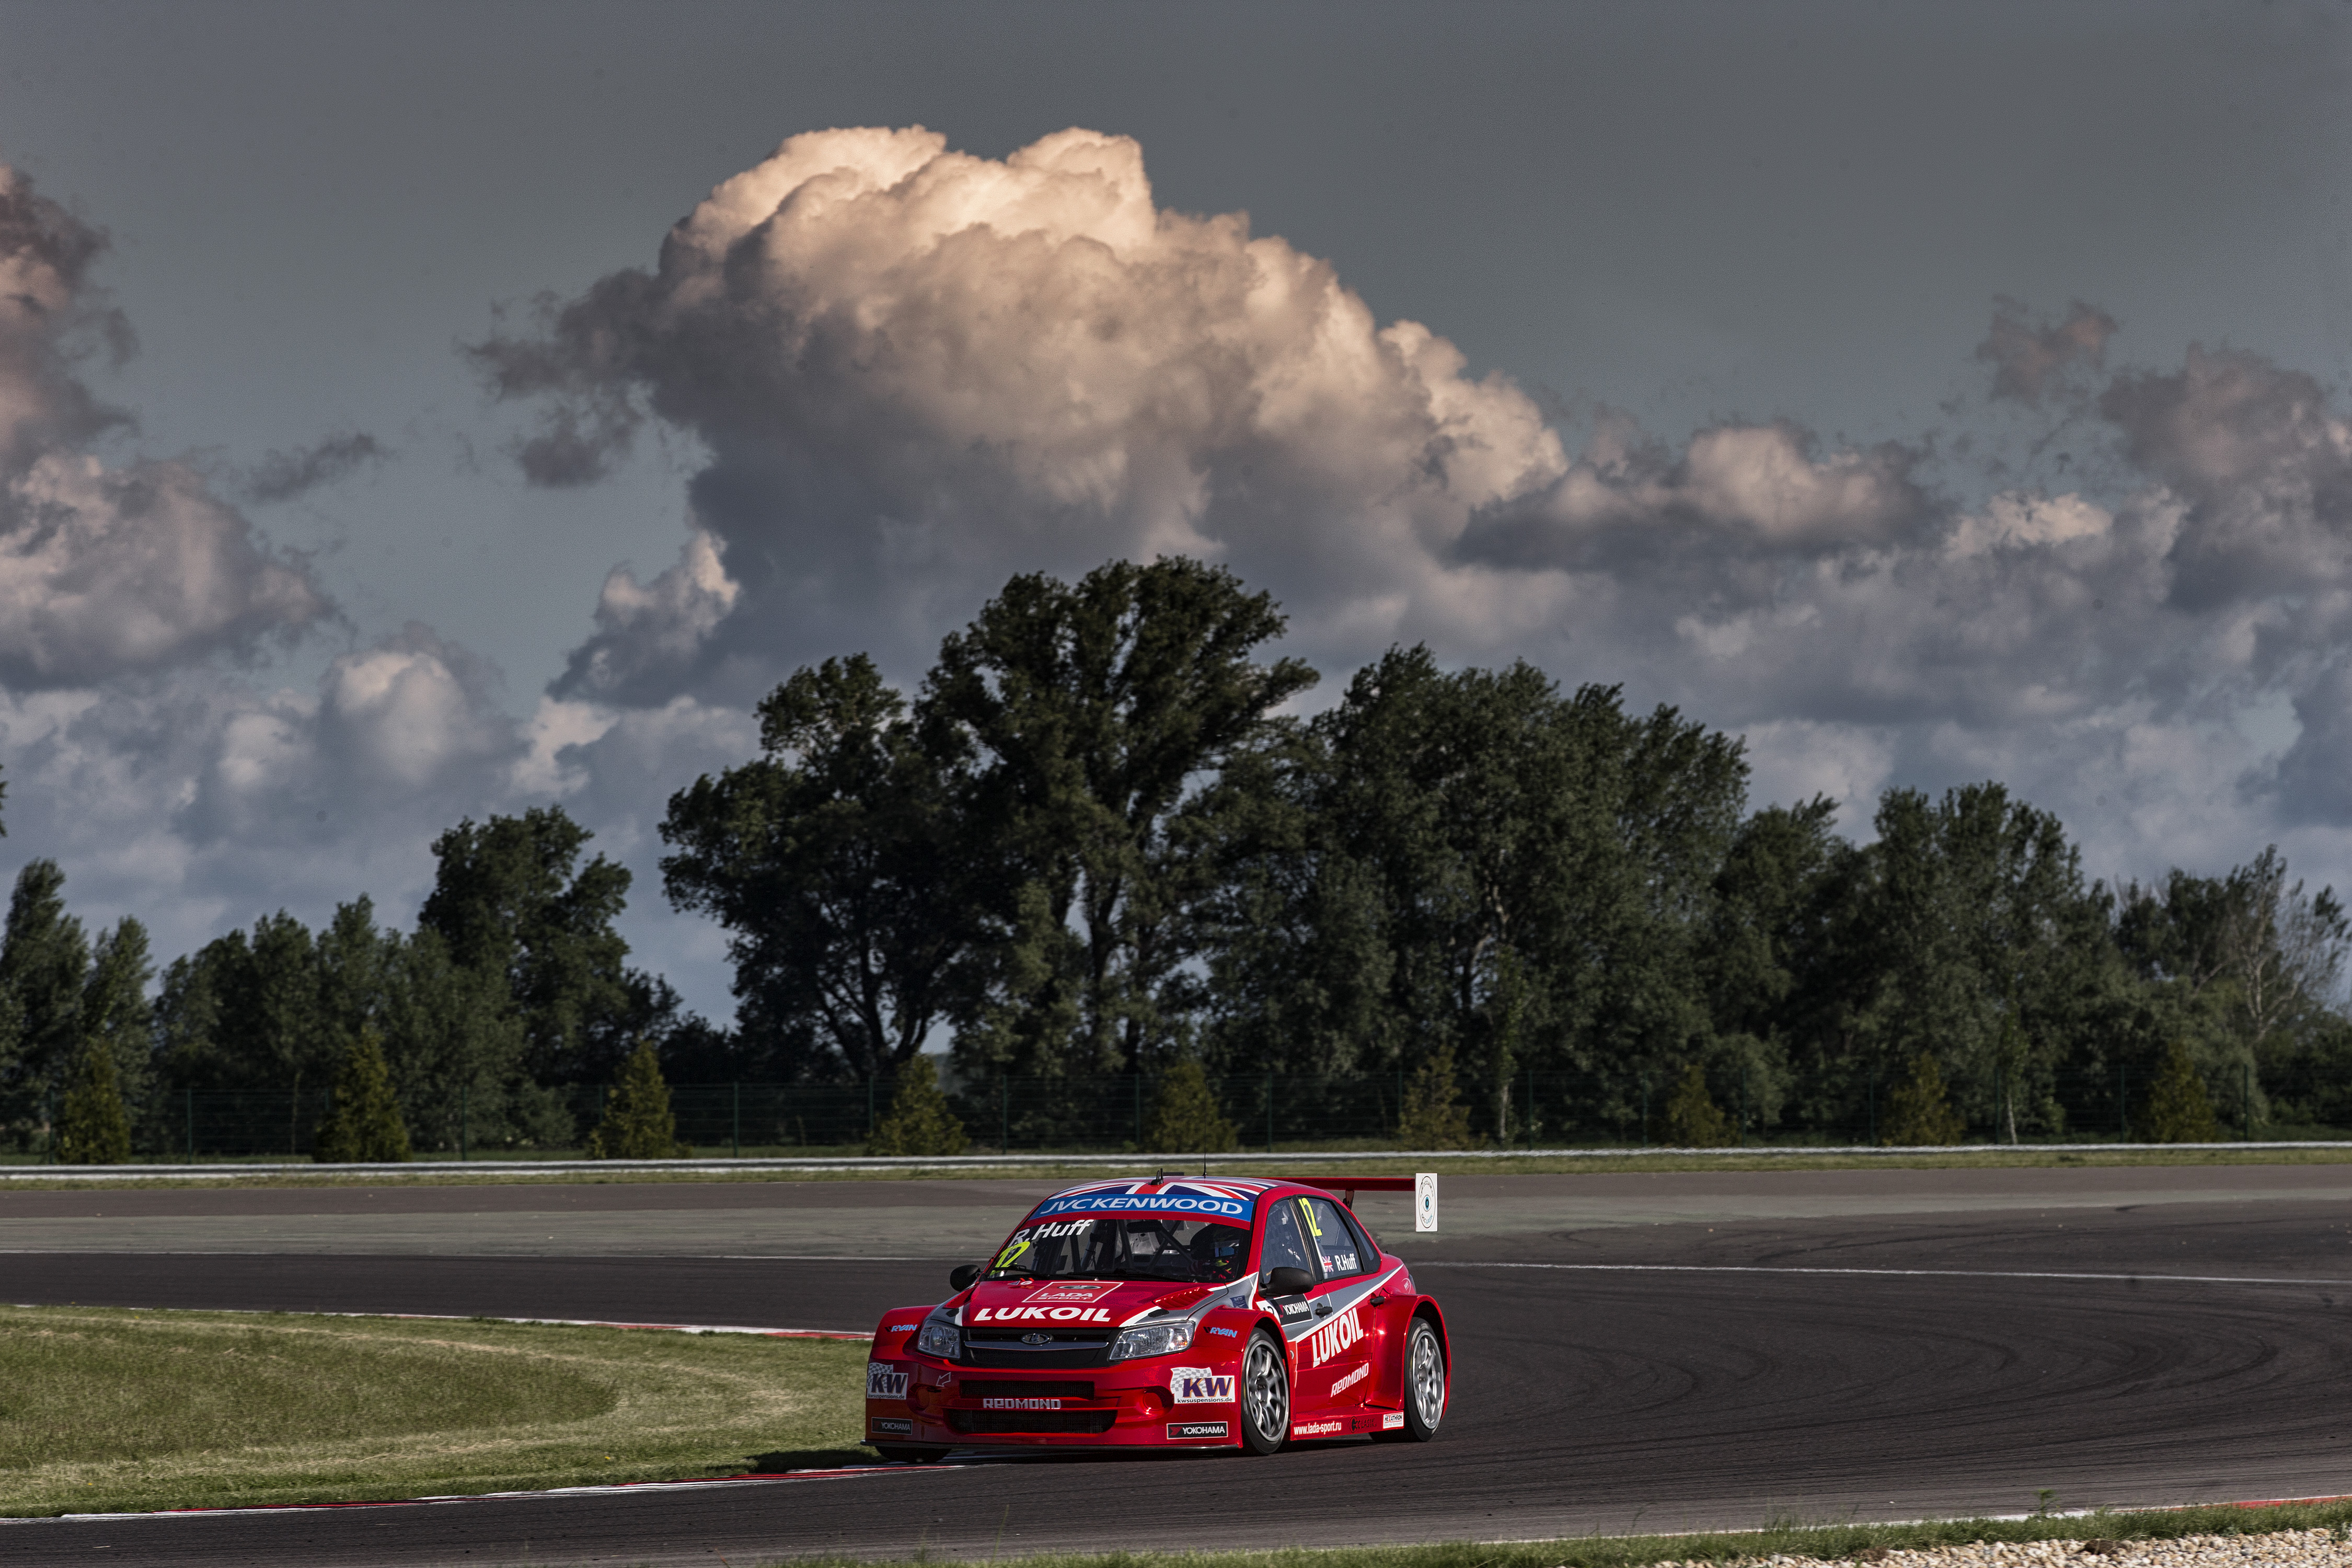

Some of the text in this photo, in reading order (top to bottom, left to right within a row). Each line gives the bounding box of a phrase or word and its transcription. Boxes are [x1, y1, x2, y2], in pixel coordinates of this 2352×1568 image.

[1040, 1197, 1243, 1214] JVCKENWOOD
[1298, 1197, 1322, 1237] 12
[989, 1241, 1030, 1276] 12
[1334, 1253, 1357, 1271] R.Huff
[974, 1307, 1111, 1322] LUKOIL
[1282, 1301, 1310, 1316] YOKOHAMA
[1209, 1327, 1238, 1338] RYAN
[1311, 1307, 1364, 1368] LUKOIL
[871, 1374, 908, 1394] KW
[1183, 1377, 1234, 1398] KW
[881, 1422, 910, 1431] YOKOHAMA
[1182, 1426, 1225, 1435] YOKOHAMA
[1294, 1421, 1342, 1435] www.lada-sport.ru
